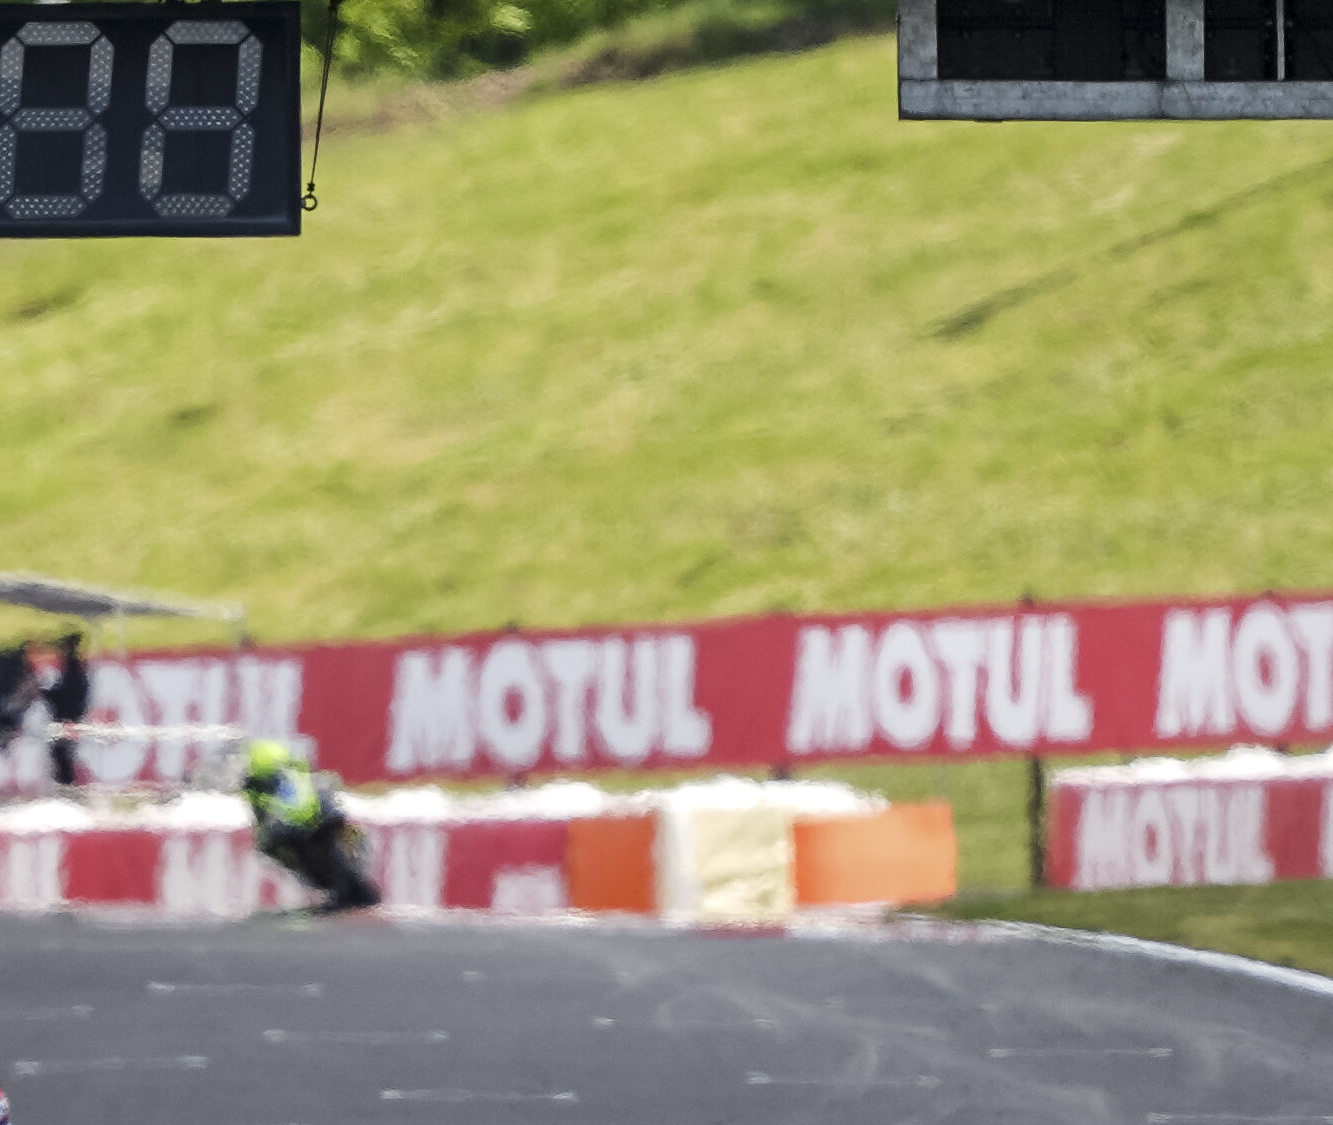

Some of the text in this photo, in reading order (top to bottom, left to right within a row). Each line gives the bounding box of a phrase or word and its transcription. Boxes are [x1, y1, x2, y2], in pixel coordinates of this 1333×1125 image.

[384, 633, 714, 773] MOTUL
[784, 611, 1096, 756] MOTUL
[1069, 782, 1277, 890] MOTUL
